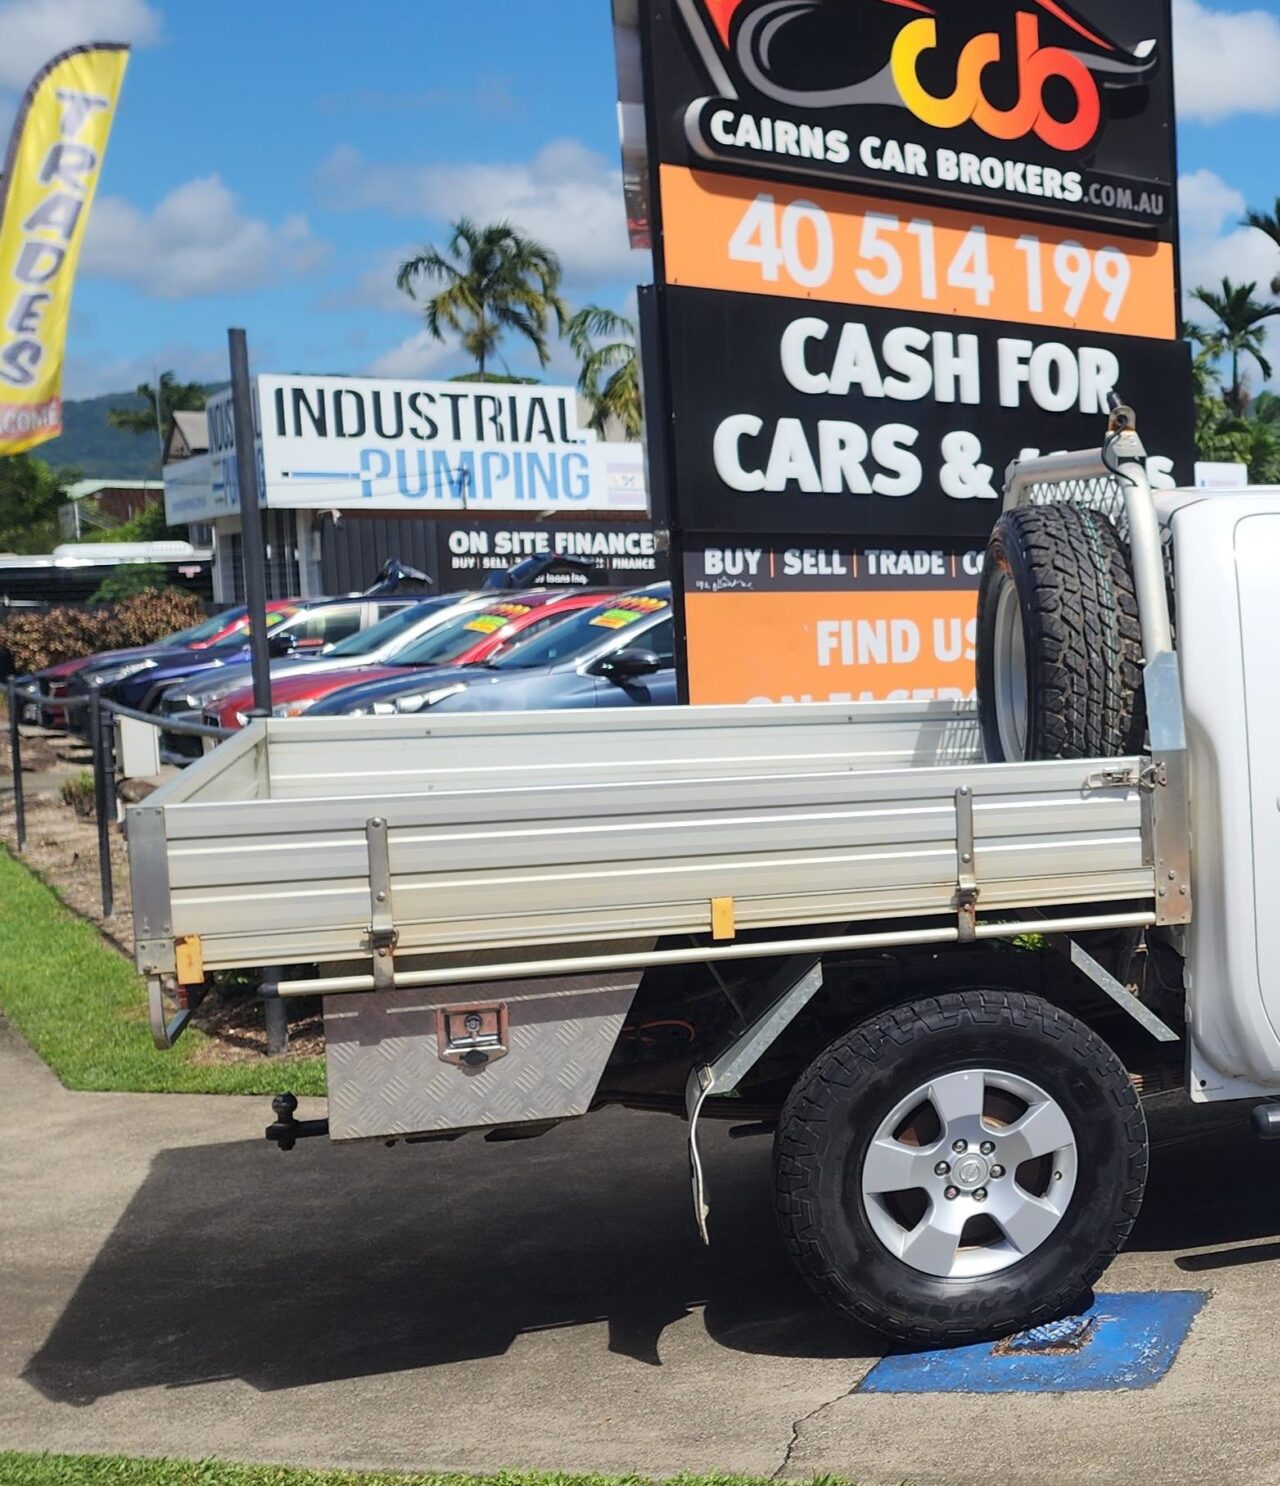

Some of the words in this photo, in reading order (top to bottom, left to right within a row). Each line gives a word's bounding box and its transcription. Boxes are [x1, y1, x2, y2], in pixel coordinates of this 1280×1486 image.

[710, 110, 850, 164] CAIRNS
[859, 135, 928, 177] CAR
[0, 87, 109, 386] TRADES
[727, 192, 834, 288] 40
[855, 211, 995, 306] 514
[1015, 233, 1131, 323] 199
[780, 317, 981, 405] CASH
[997, 337, 1120, 415] FOR
[274, 387, 578, 444] INDUSTRIAL
[360, 448, 590, 500] PUMPING
[713, 414, 923, 497] CARS
[940, 431, 998, 499] &
[449, 531, 488, 554] ON
[494, 531, 549, 554] SITE
[555, 532, 655, 555] FINANCE
[452, 557, 475, 569] BUY
[482, 557, 509, 569] SELL
[612, 557, 655, 570] FINANCE
[704, 548, 762, 576] BUY
[783, 549, 847, 576] SELL
[864, 550, 945, 576] TRADE
[817, 619, 921, 667] FIND
